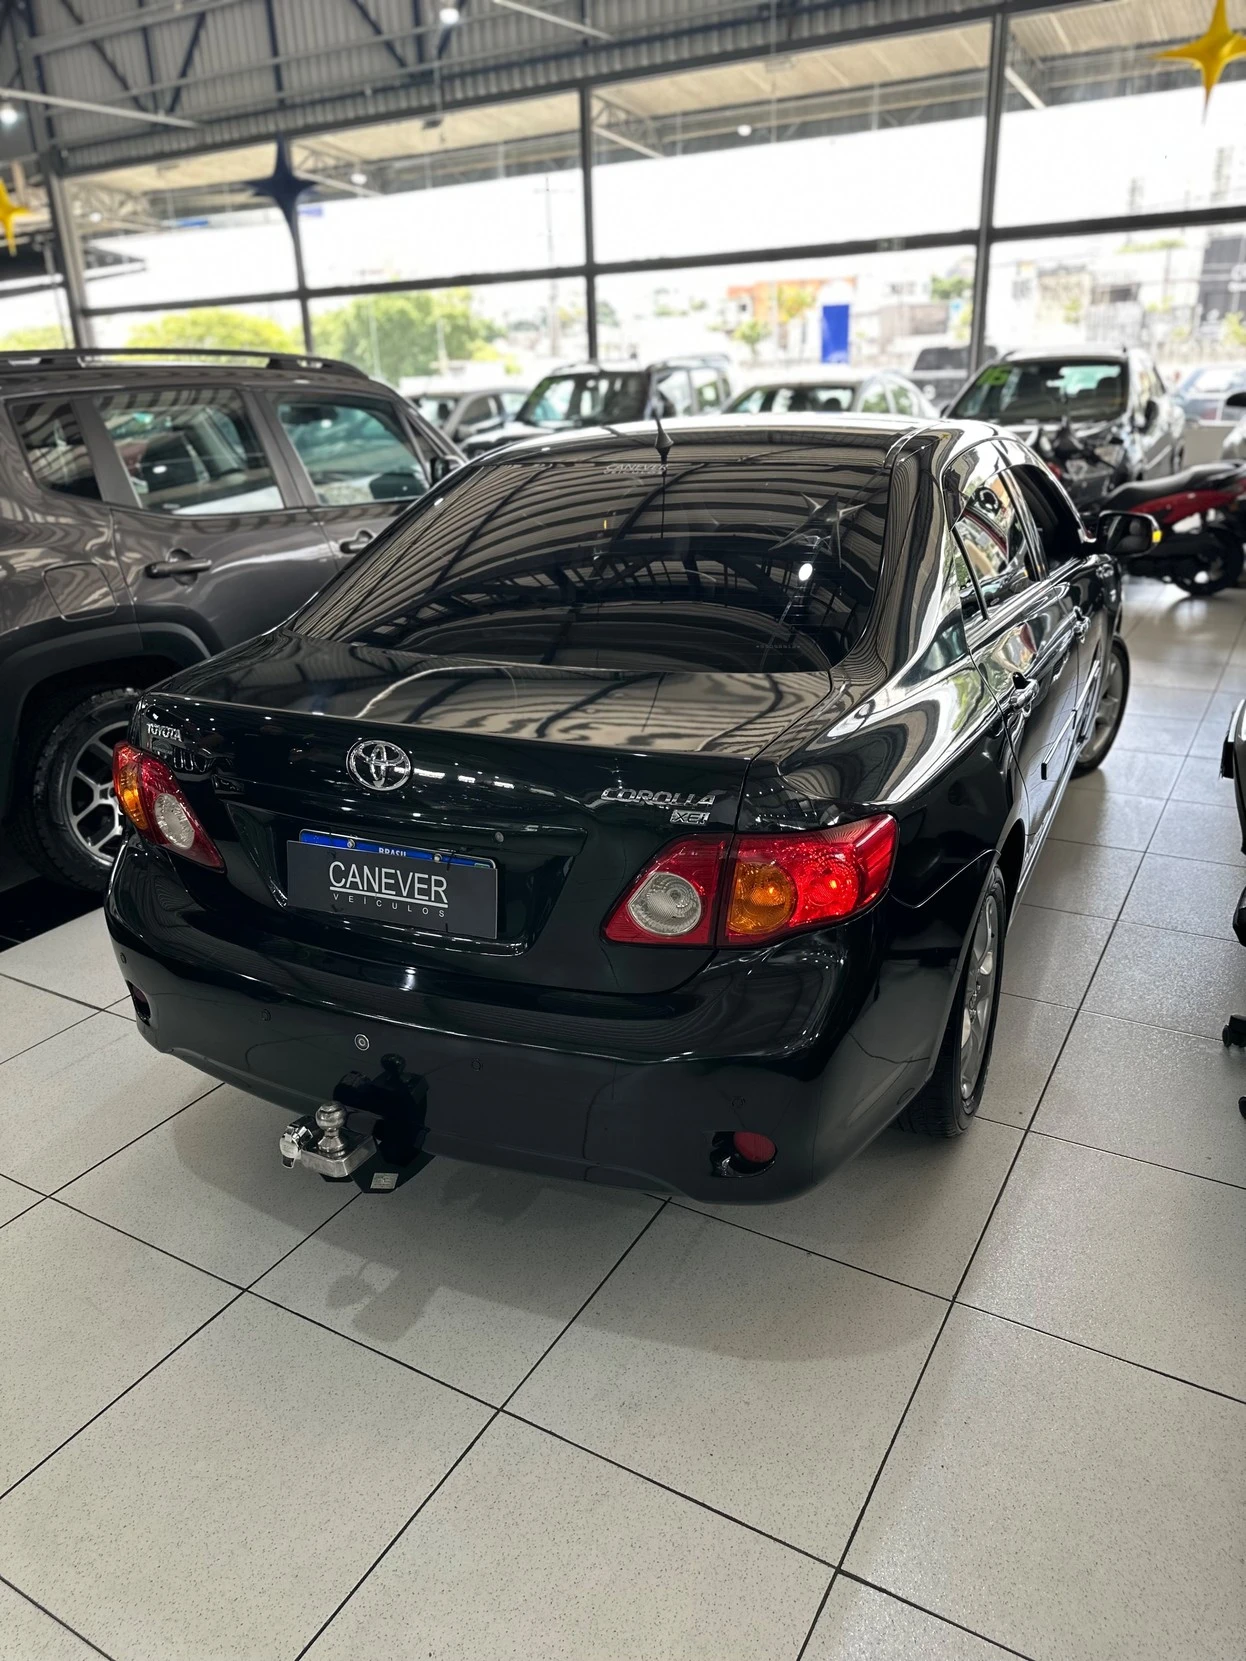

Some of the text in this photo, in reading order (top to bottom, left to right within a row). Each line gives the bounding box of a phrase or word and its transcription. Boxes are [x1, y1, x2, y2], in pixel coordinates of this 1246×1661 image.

[146, 723, 183, 743] TOYOTA
[600, 787, 716, 806] COROLLA
[329, 861, 448, 903] CANEVER
[333, 893, 445, 918] VEICULOS
